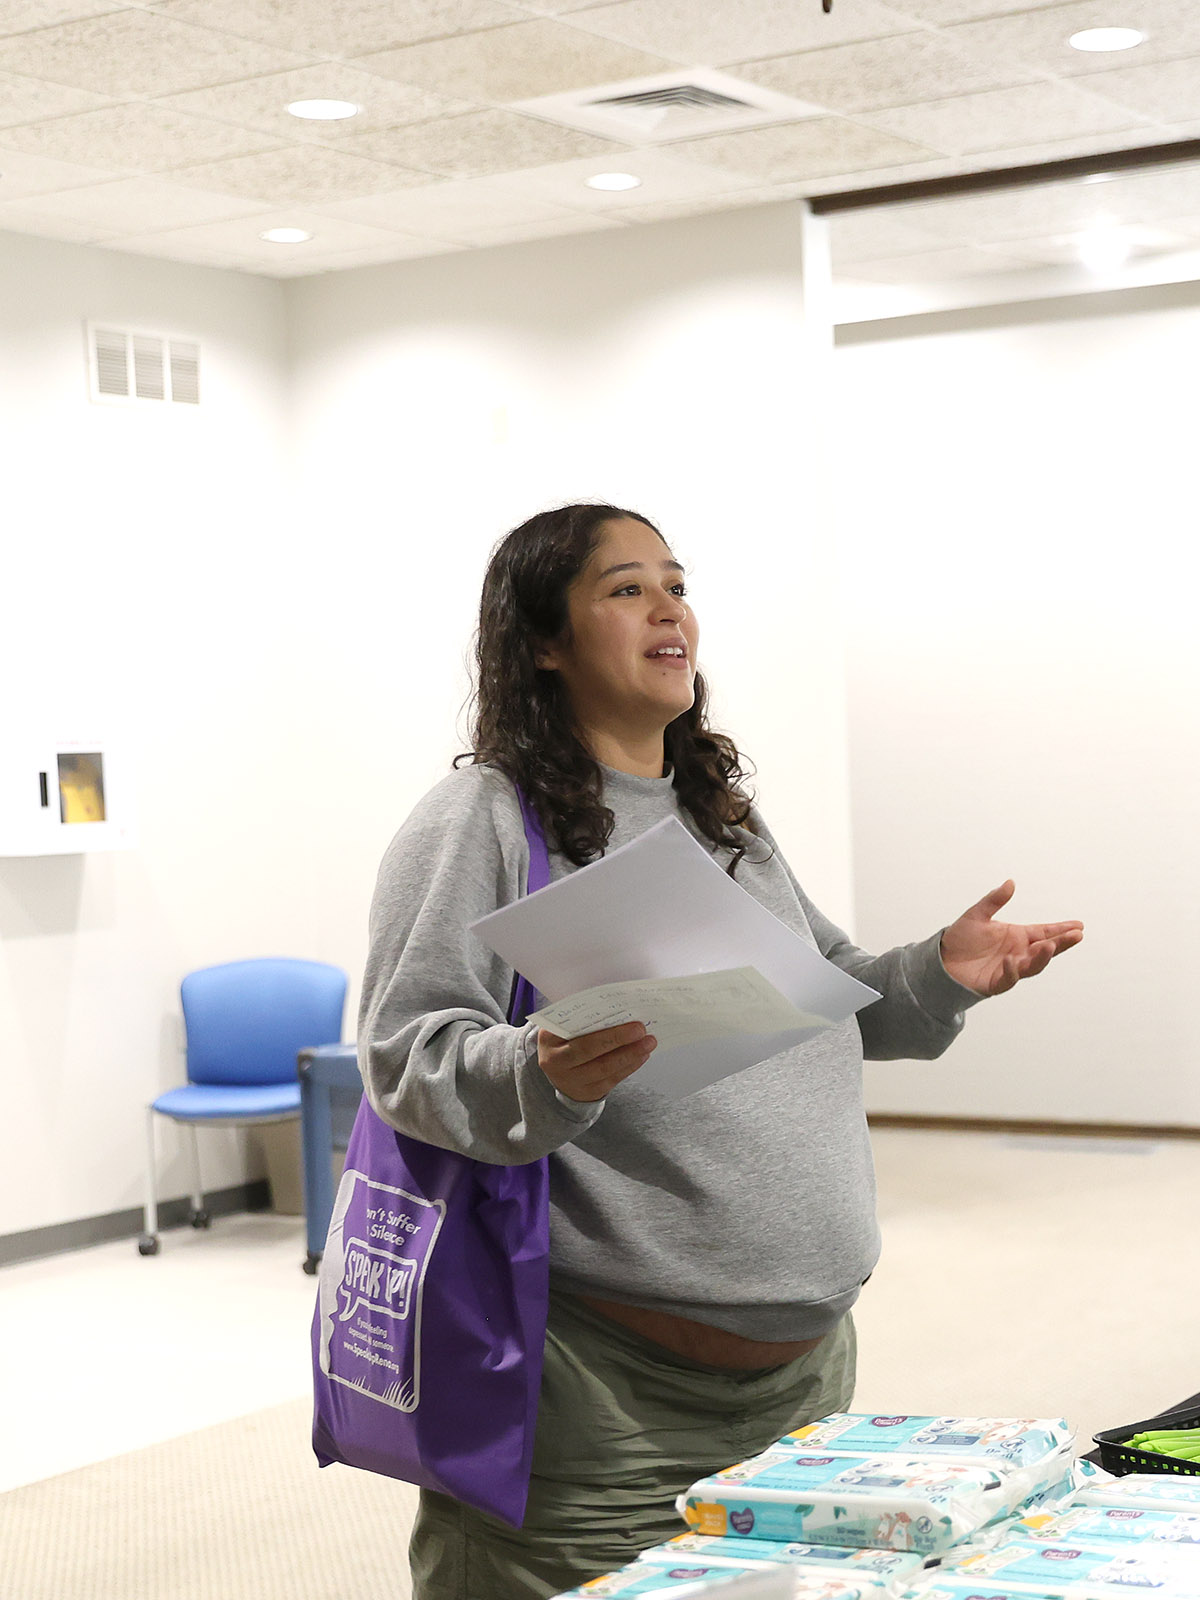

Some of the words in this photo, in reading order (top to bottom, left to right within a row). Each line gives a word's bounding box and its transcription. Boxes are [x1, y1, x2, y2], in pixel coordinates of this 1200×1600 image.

[370, 1224, 405, 1246] Silece
[386, 1210, 421, 1235] Suffer
[346, 1250, 385, 1299] SPEAK
